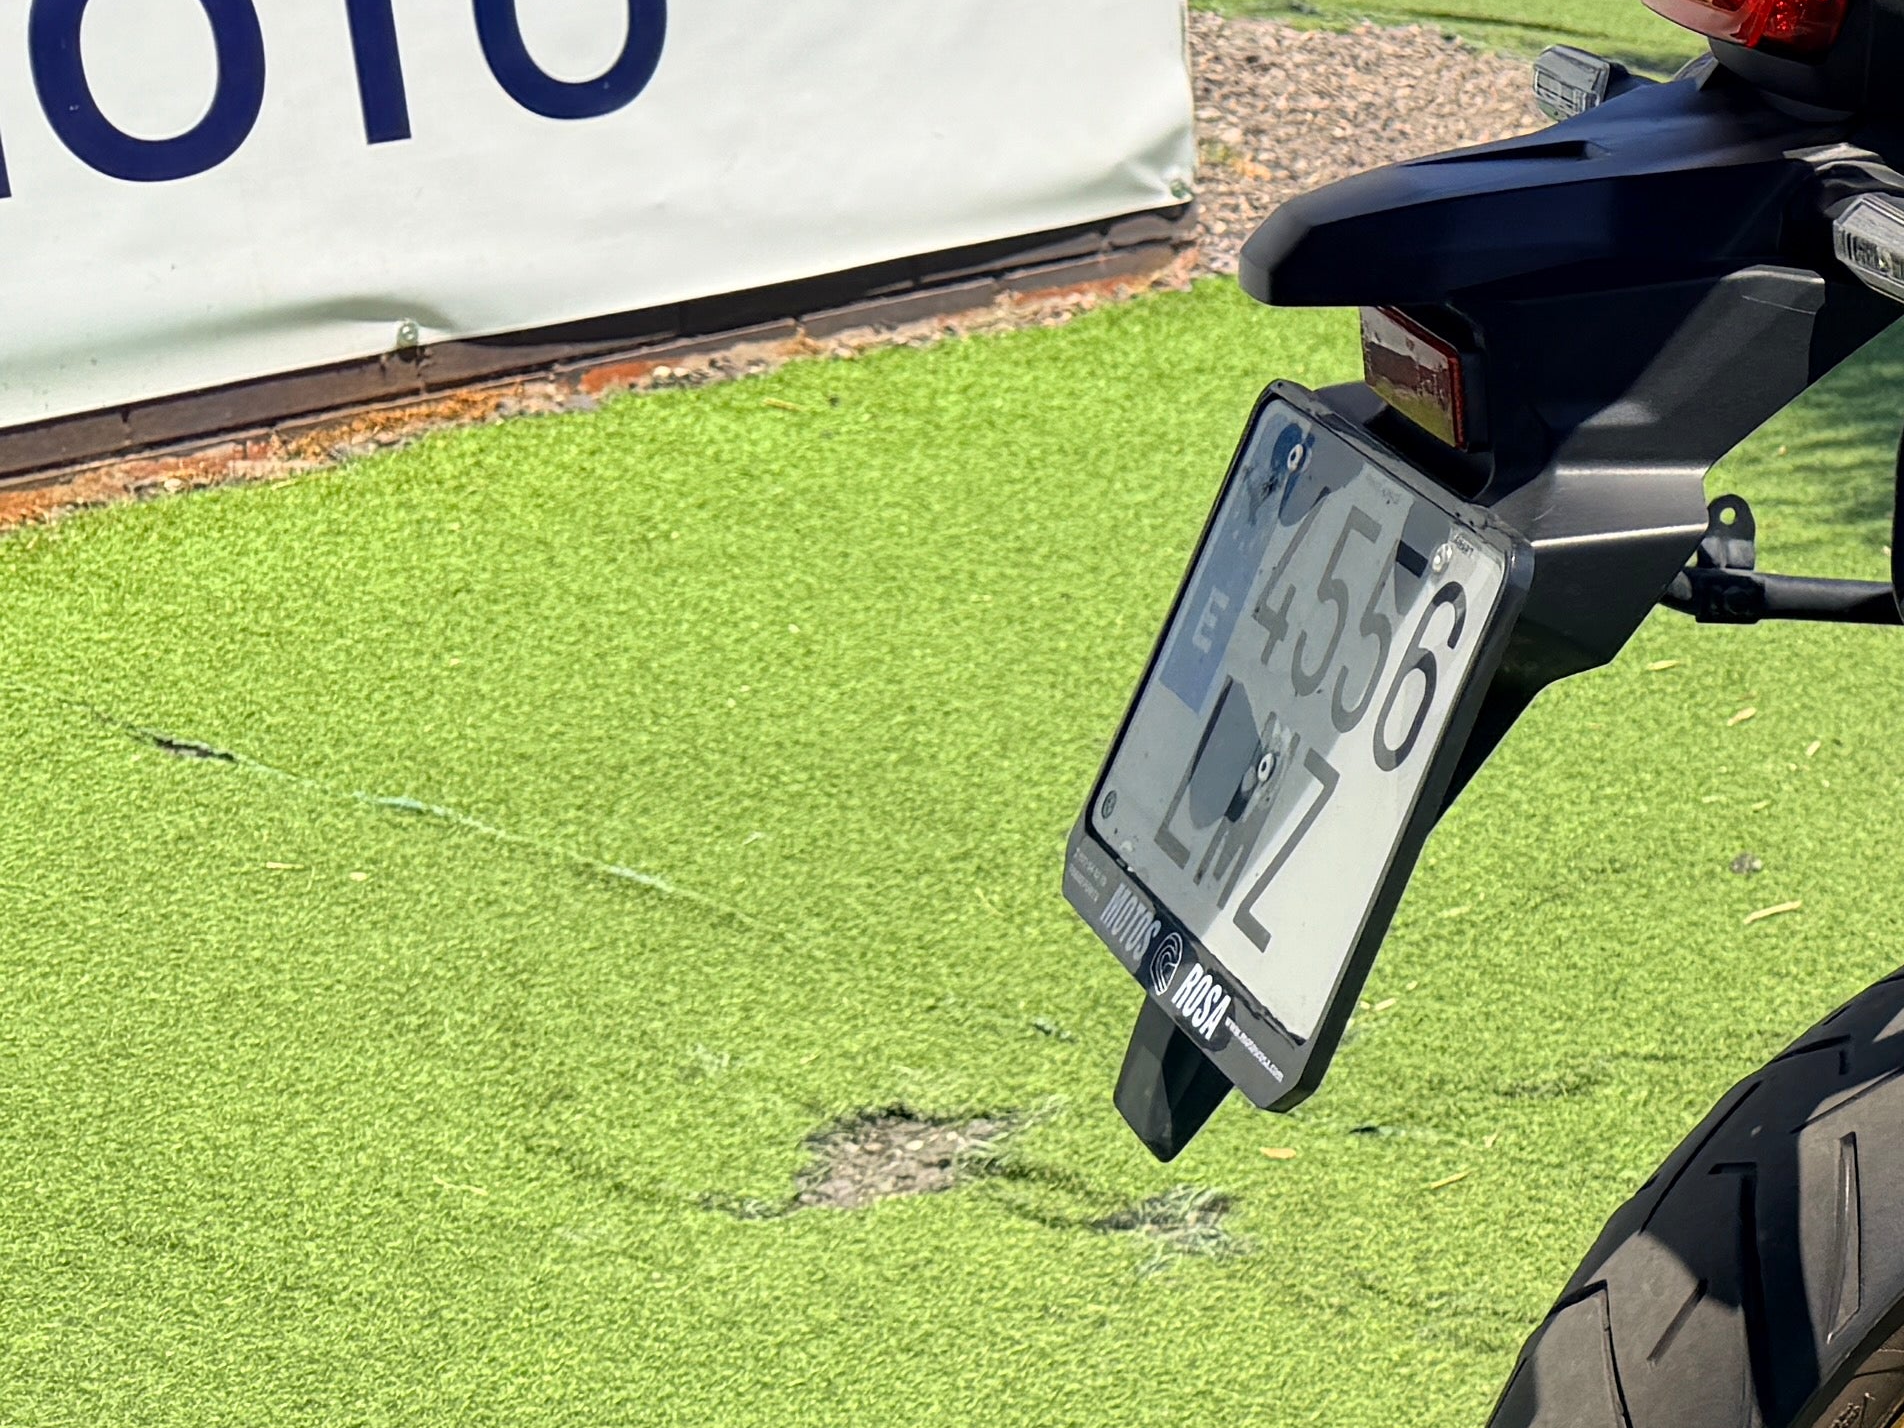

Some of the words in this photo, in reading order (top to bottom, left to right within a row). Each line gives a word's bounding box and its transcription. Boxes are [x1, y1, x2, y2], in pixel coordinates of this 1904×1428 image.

[1252, 486, 1467, 772] 4556
[1100, 882, 1161, 961] MOTOS
[1171, 963, 1231, 1041] ROSA
